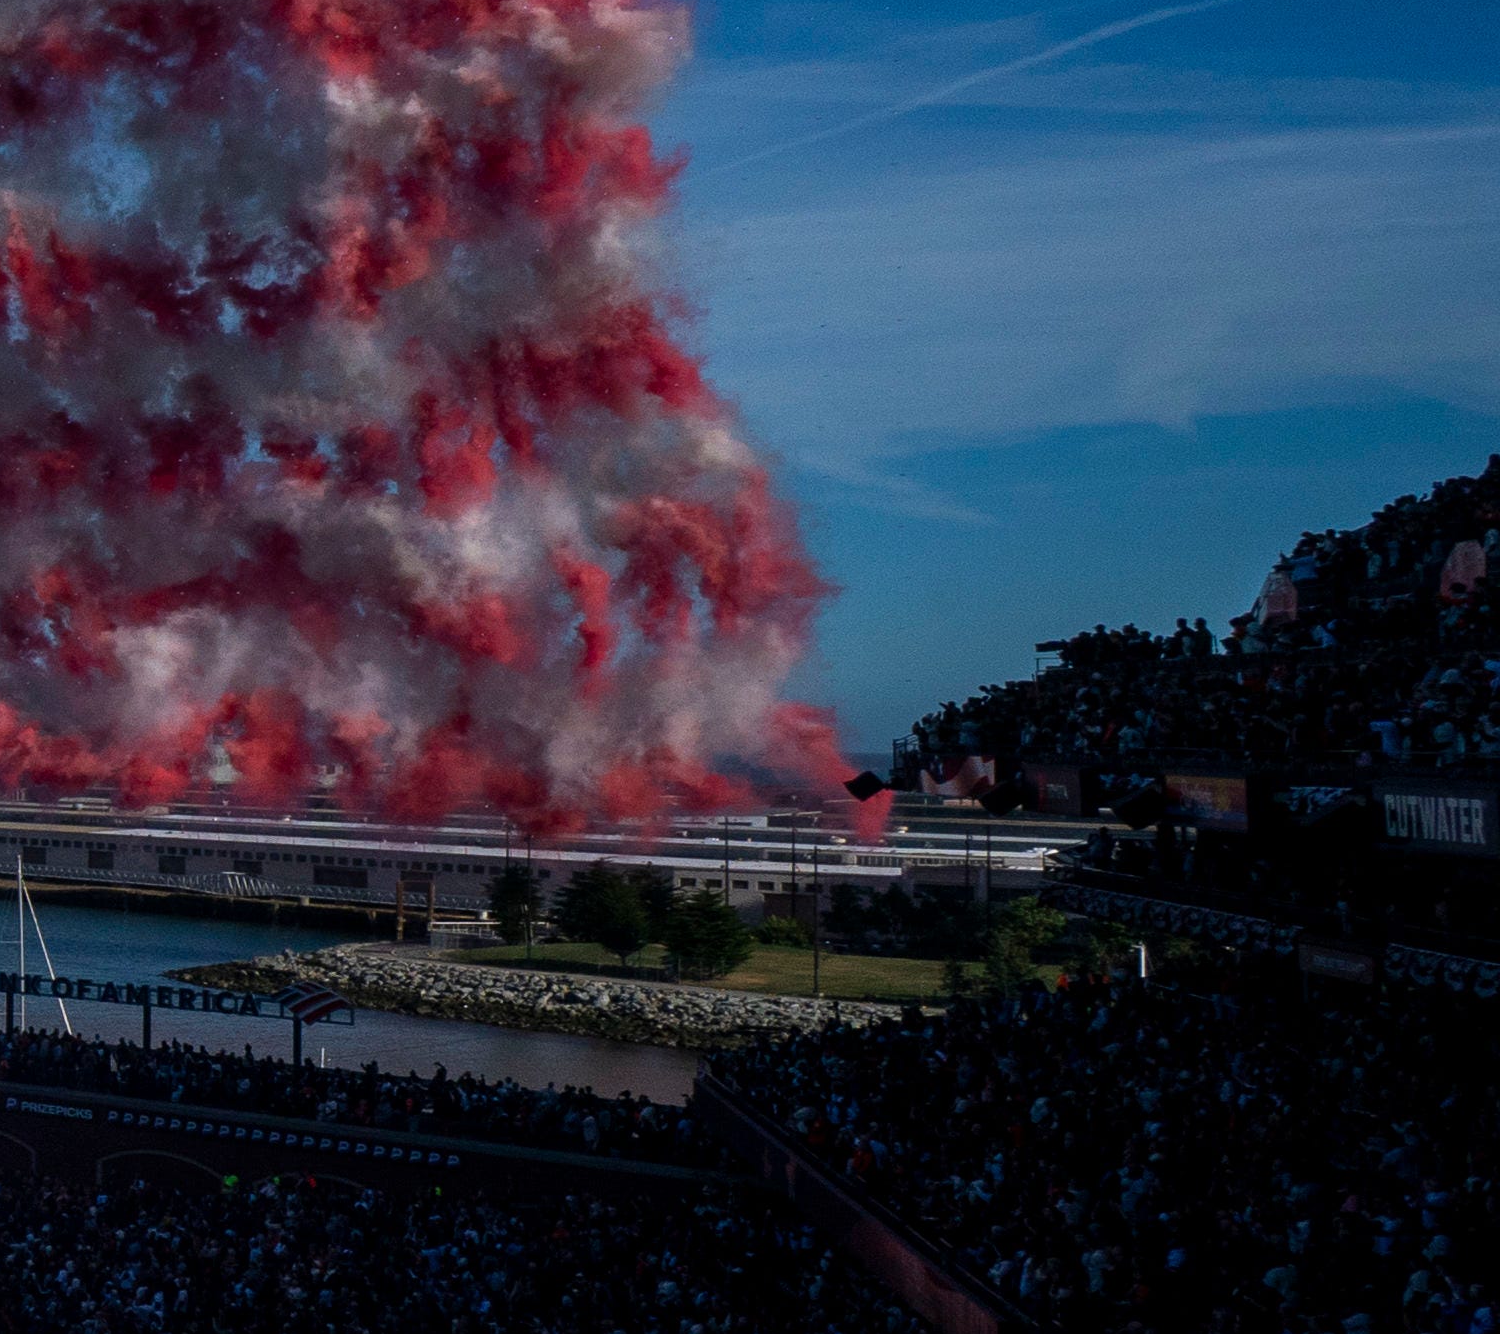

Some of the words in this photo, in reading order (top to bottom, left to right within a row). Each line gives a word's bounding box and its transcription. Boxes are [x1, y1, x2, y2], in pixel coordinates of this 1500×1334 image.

[1383, 793, 1486, 845] CUTWATER
[51, 976, 92, 1000] OF
[100, 982, 260, 1017] AMERICA
[20, 1099, 94, 1121] PRIZEPICKS
